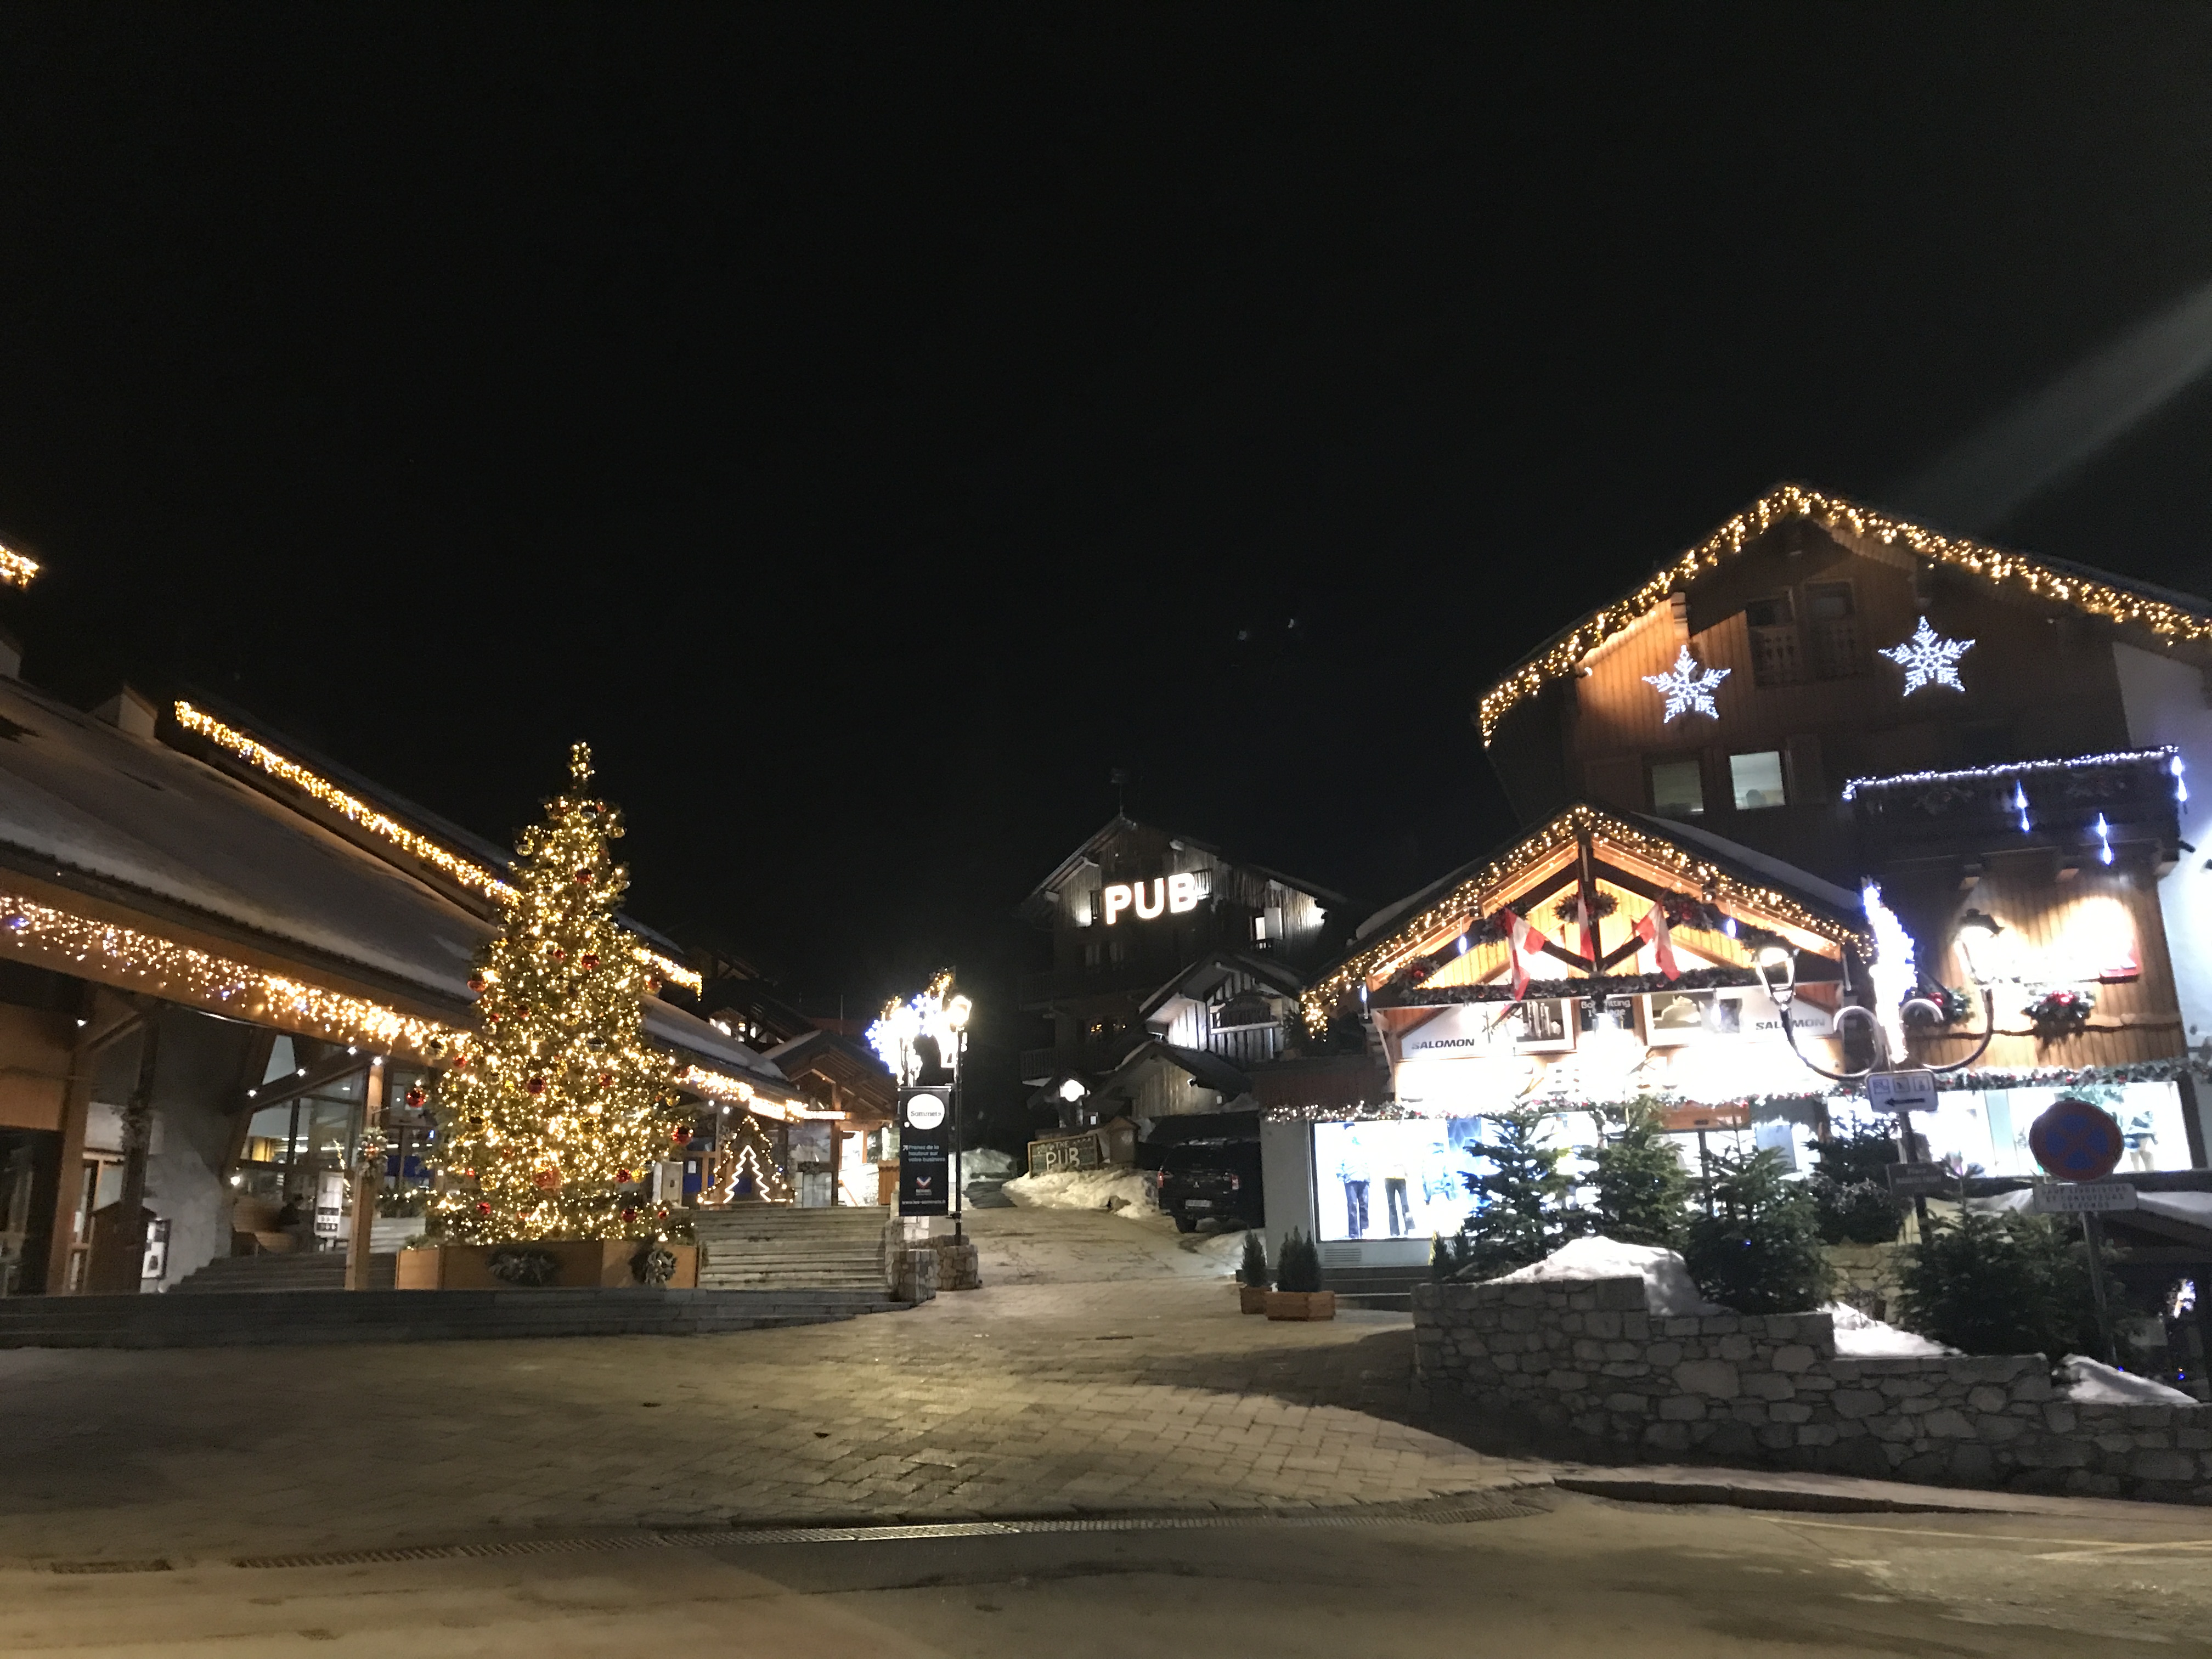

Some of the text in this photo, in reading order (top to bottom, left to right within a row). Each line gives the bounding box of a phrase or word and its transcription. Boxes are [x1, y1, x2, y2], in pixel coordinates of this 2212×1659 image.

[1105, 872, 1198, 925] PUB
[1756, 1019, 1825, 1030] SALMON
[1411, 1039, 1475, 1049] SALOMON
[1054, 1141, 1069, 1150] THE
[1046, 1147, 1080, 1171] PUB
